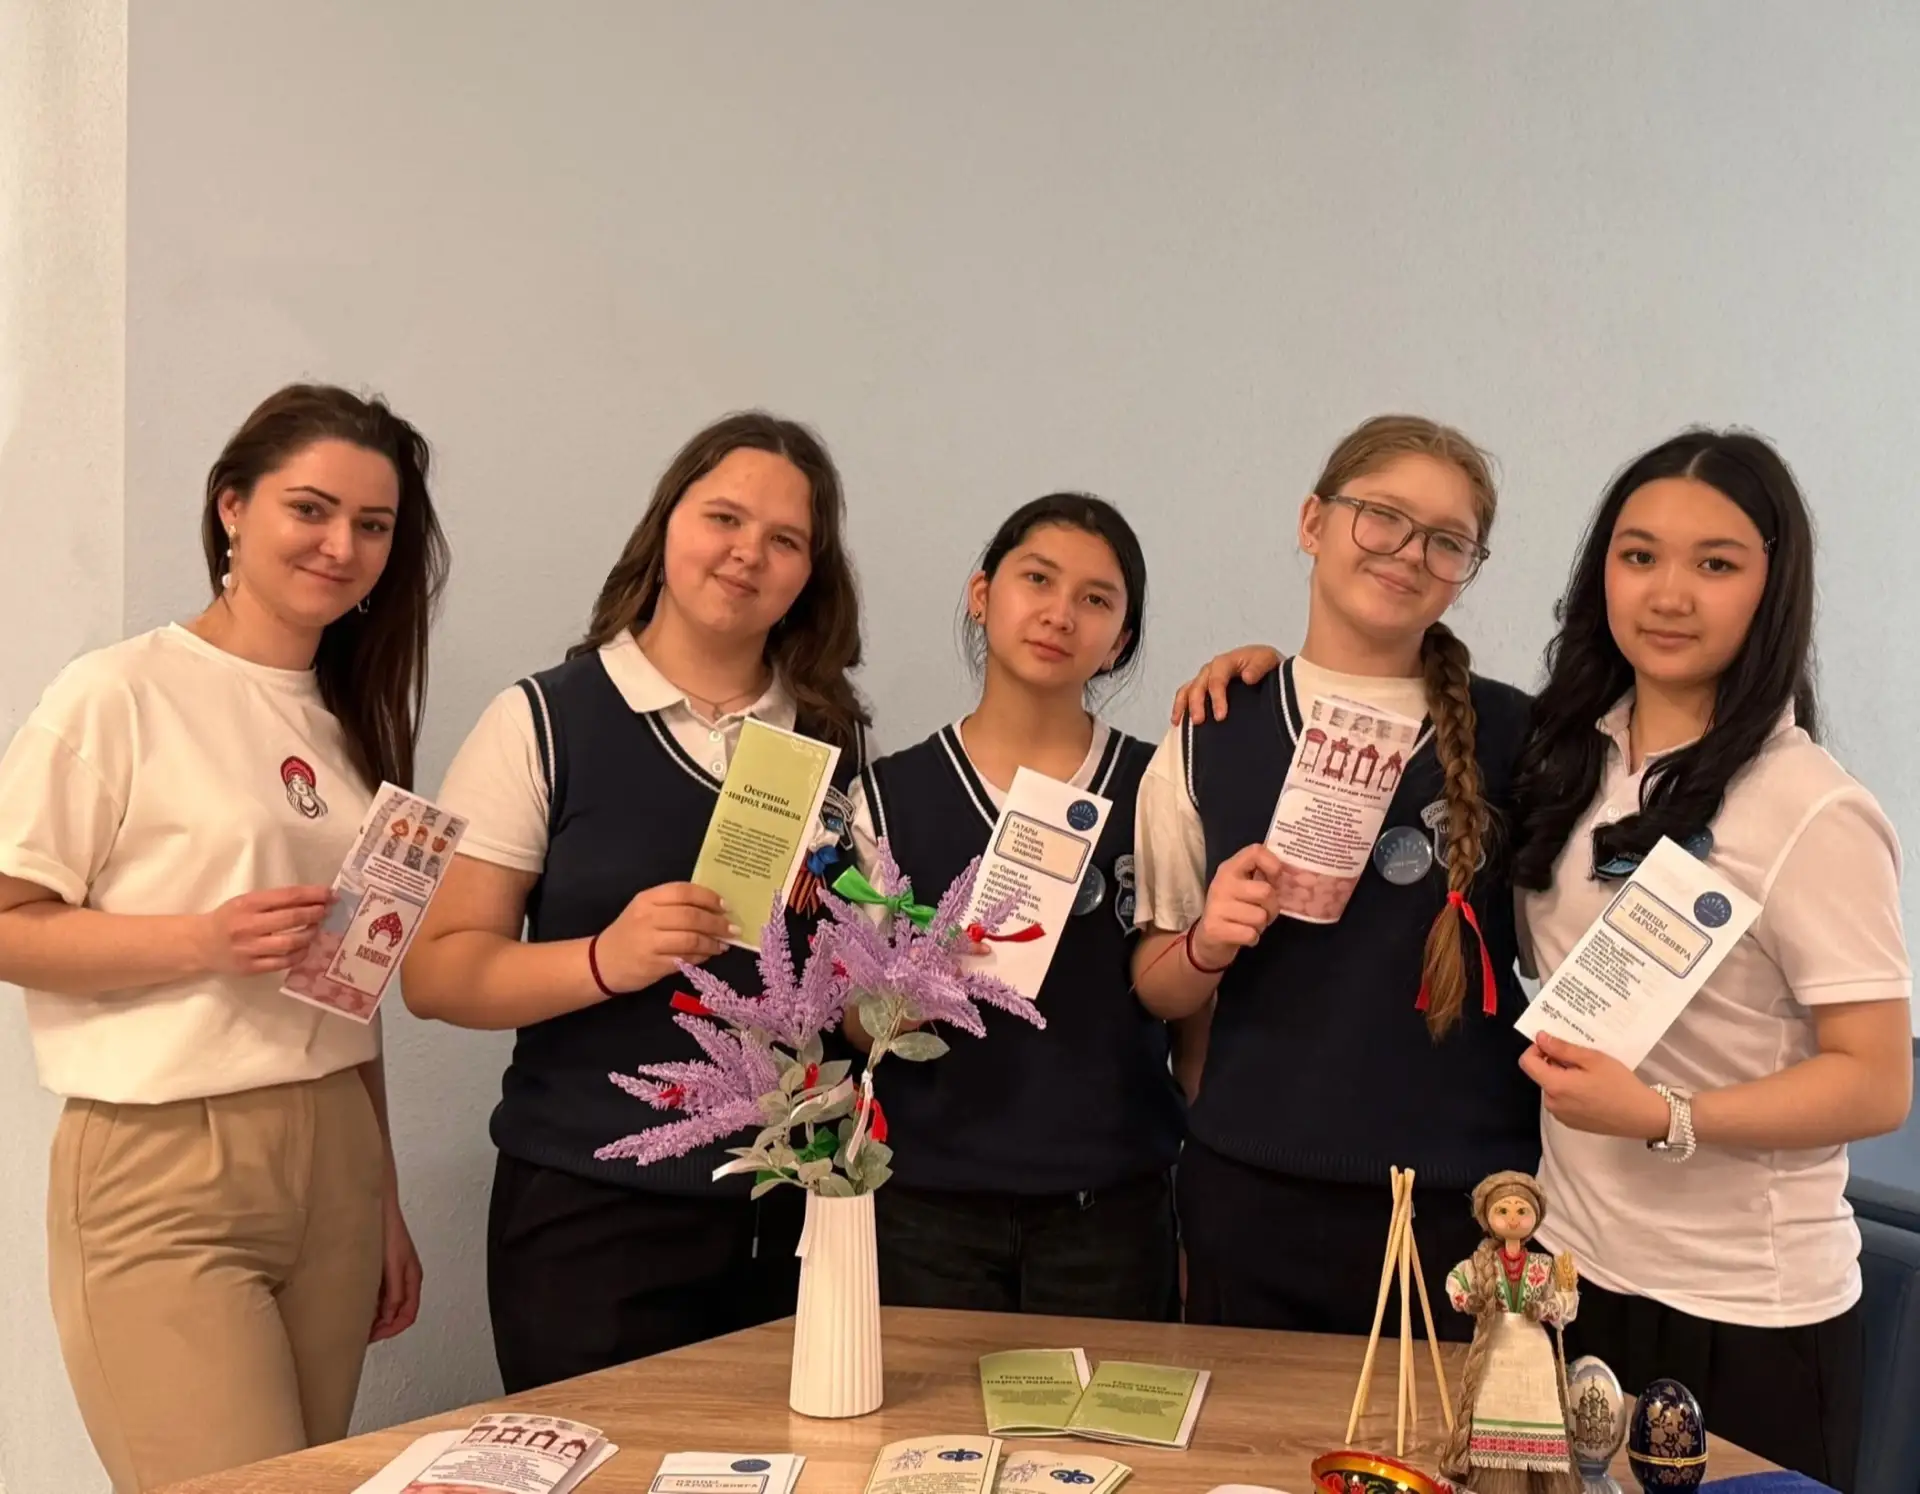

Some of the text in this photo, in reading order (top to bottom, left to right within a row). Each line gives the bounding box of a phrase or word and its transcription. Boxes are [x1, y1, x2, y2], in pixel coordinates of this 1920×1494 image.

[743, 783, 791, 807] Осетины
[761, 802, 802, 821] кавказа
[1012, 820, 1039, 837] ТАТАРЫ
[1634, 902, 1668, 931] НЕНЦЫ
[1628, 910, 1660, 937] НАРОД
[1658, 932, 1692, 962] СЕВЕРА
